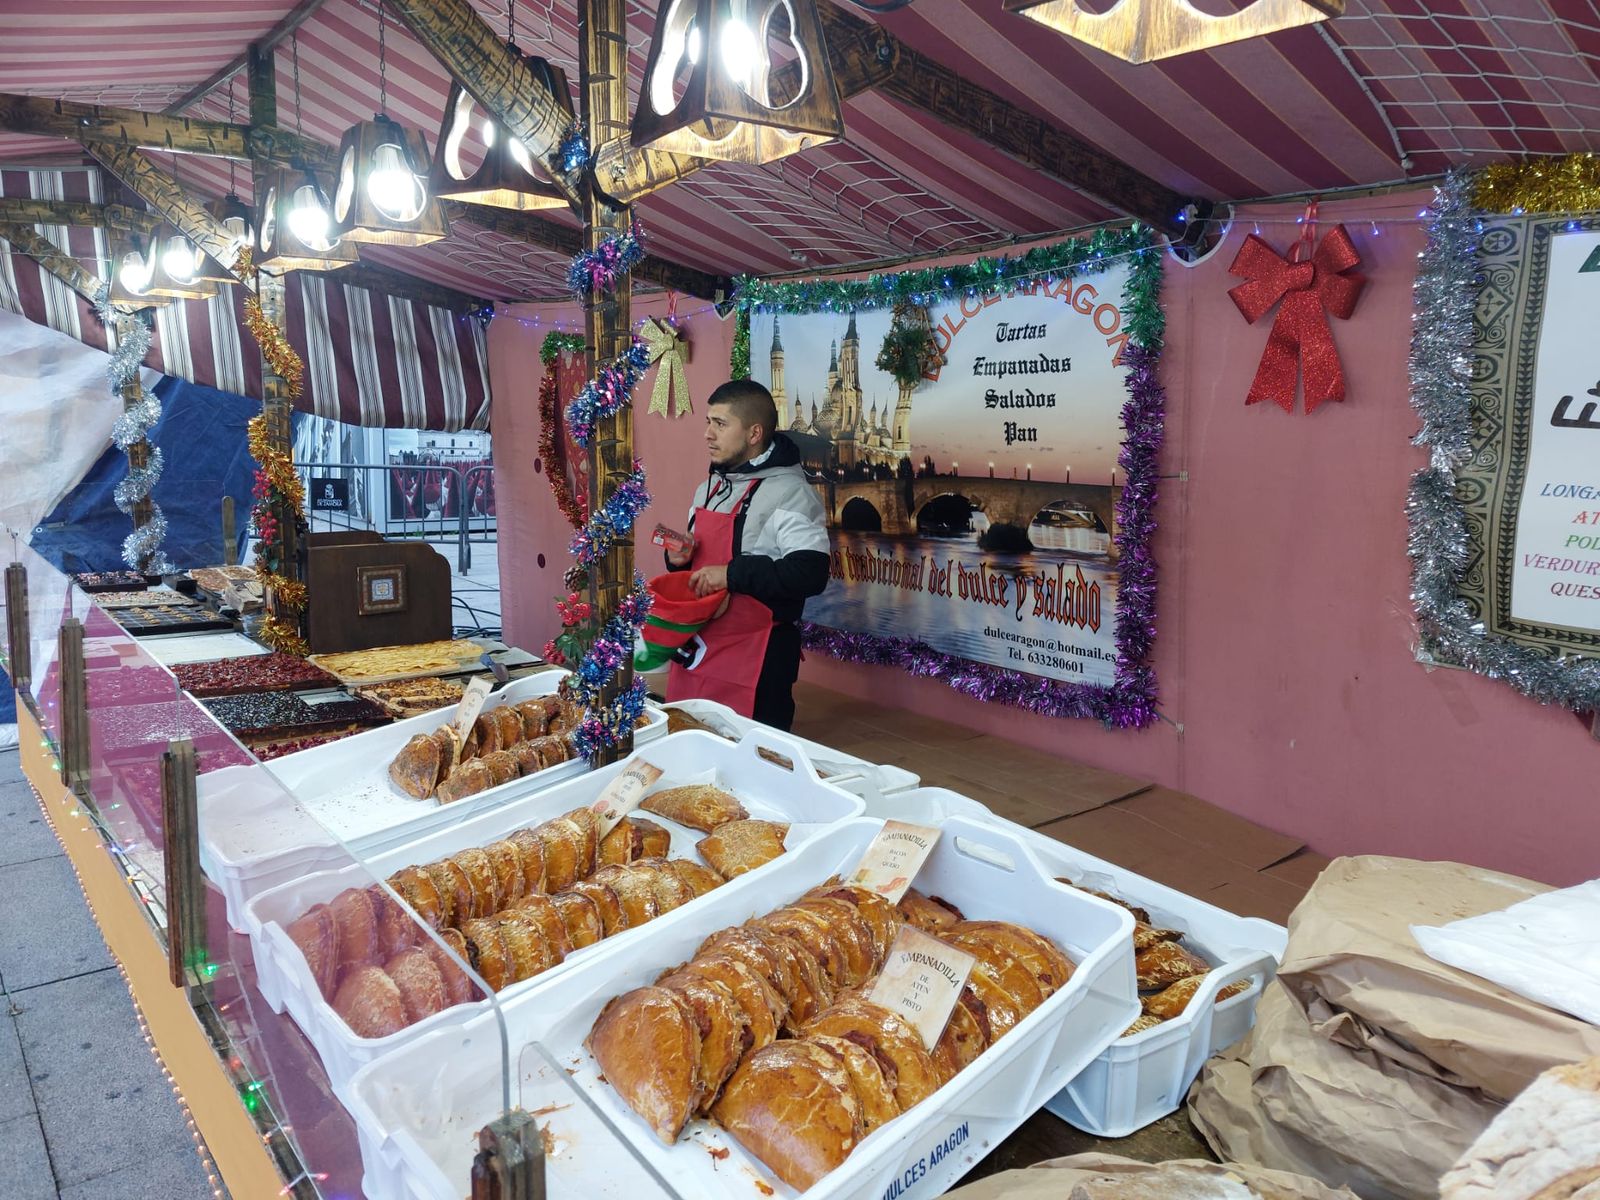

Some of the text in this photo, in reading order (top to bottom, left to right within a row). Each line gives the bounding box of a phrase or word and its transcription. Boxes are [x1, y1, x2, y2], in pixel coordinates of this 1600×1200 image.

[995, 322, 1047, 343] Tartas
[973, 353, 1072, 379] Empanadas
[984, 388, 1056, 409] Salados
[1003, 421, 1038, 446] Pan
[928, 557, 954, 599] del
[957, 560, 1009, 608] dulce
[1032, 562, 1101, 635] salado
[983, 626, 1117, 663] dulcearagon@hotmail.es
[1008, 646, 1084, 674] Tel. 633280601
[901, 952, 960, 988] EMPANADILLA
[919, 974, 929, 984] DE
[930, 1121, 969, 1170] ARAGON
